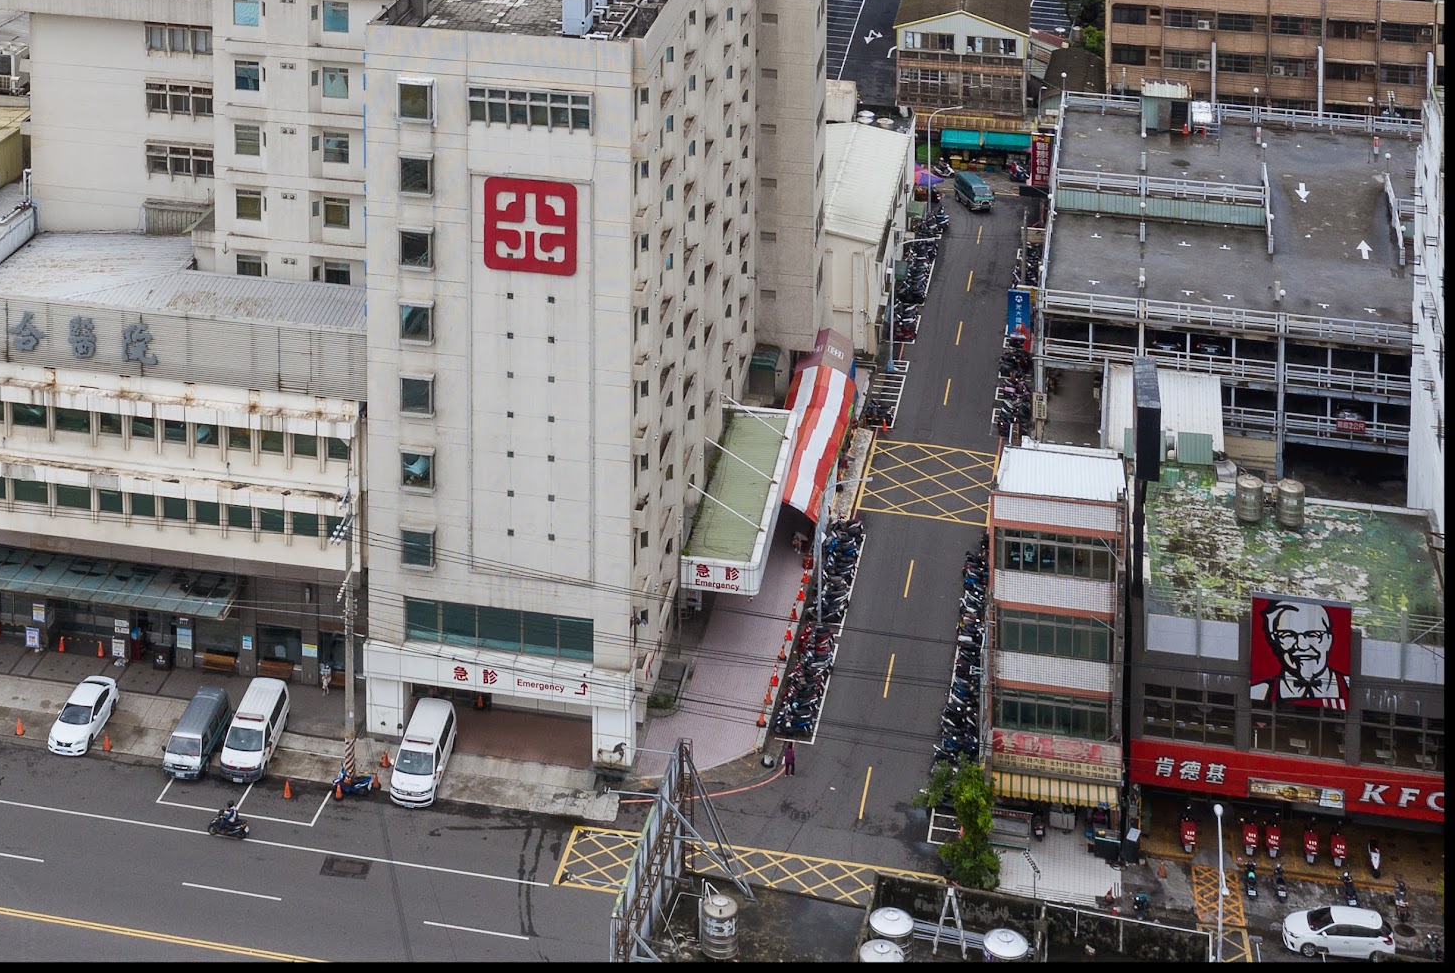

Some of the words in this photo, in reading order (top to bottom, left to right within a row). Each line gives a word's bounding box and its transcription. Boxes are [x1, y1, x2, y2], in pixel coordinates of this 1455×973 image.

[695, 578, 739, 592] Emergency
[696, 563, 739, 580] 急診
[453, 666, 498, 685] 急診
[517, 678, 565, 694] Emergency
[1155, 756, 1226, 784] 肯德基
[1359, 782, 1445, 812] KFC
